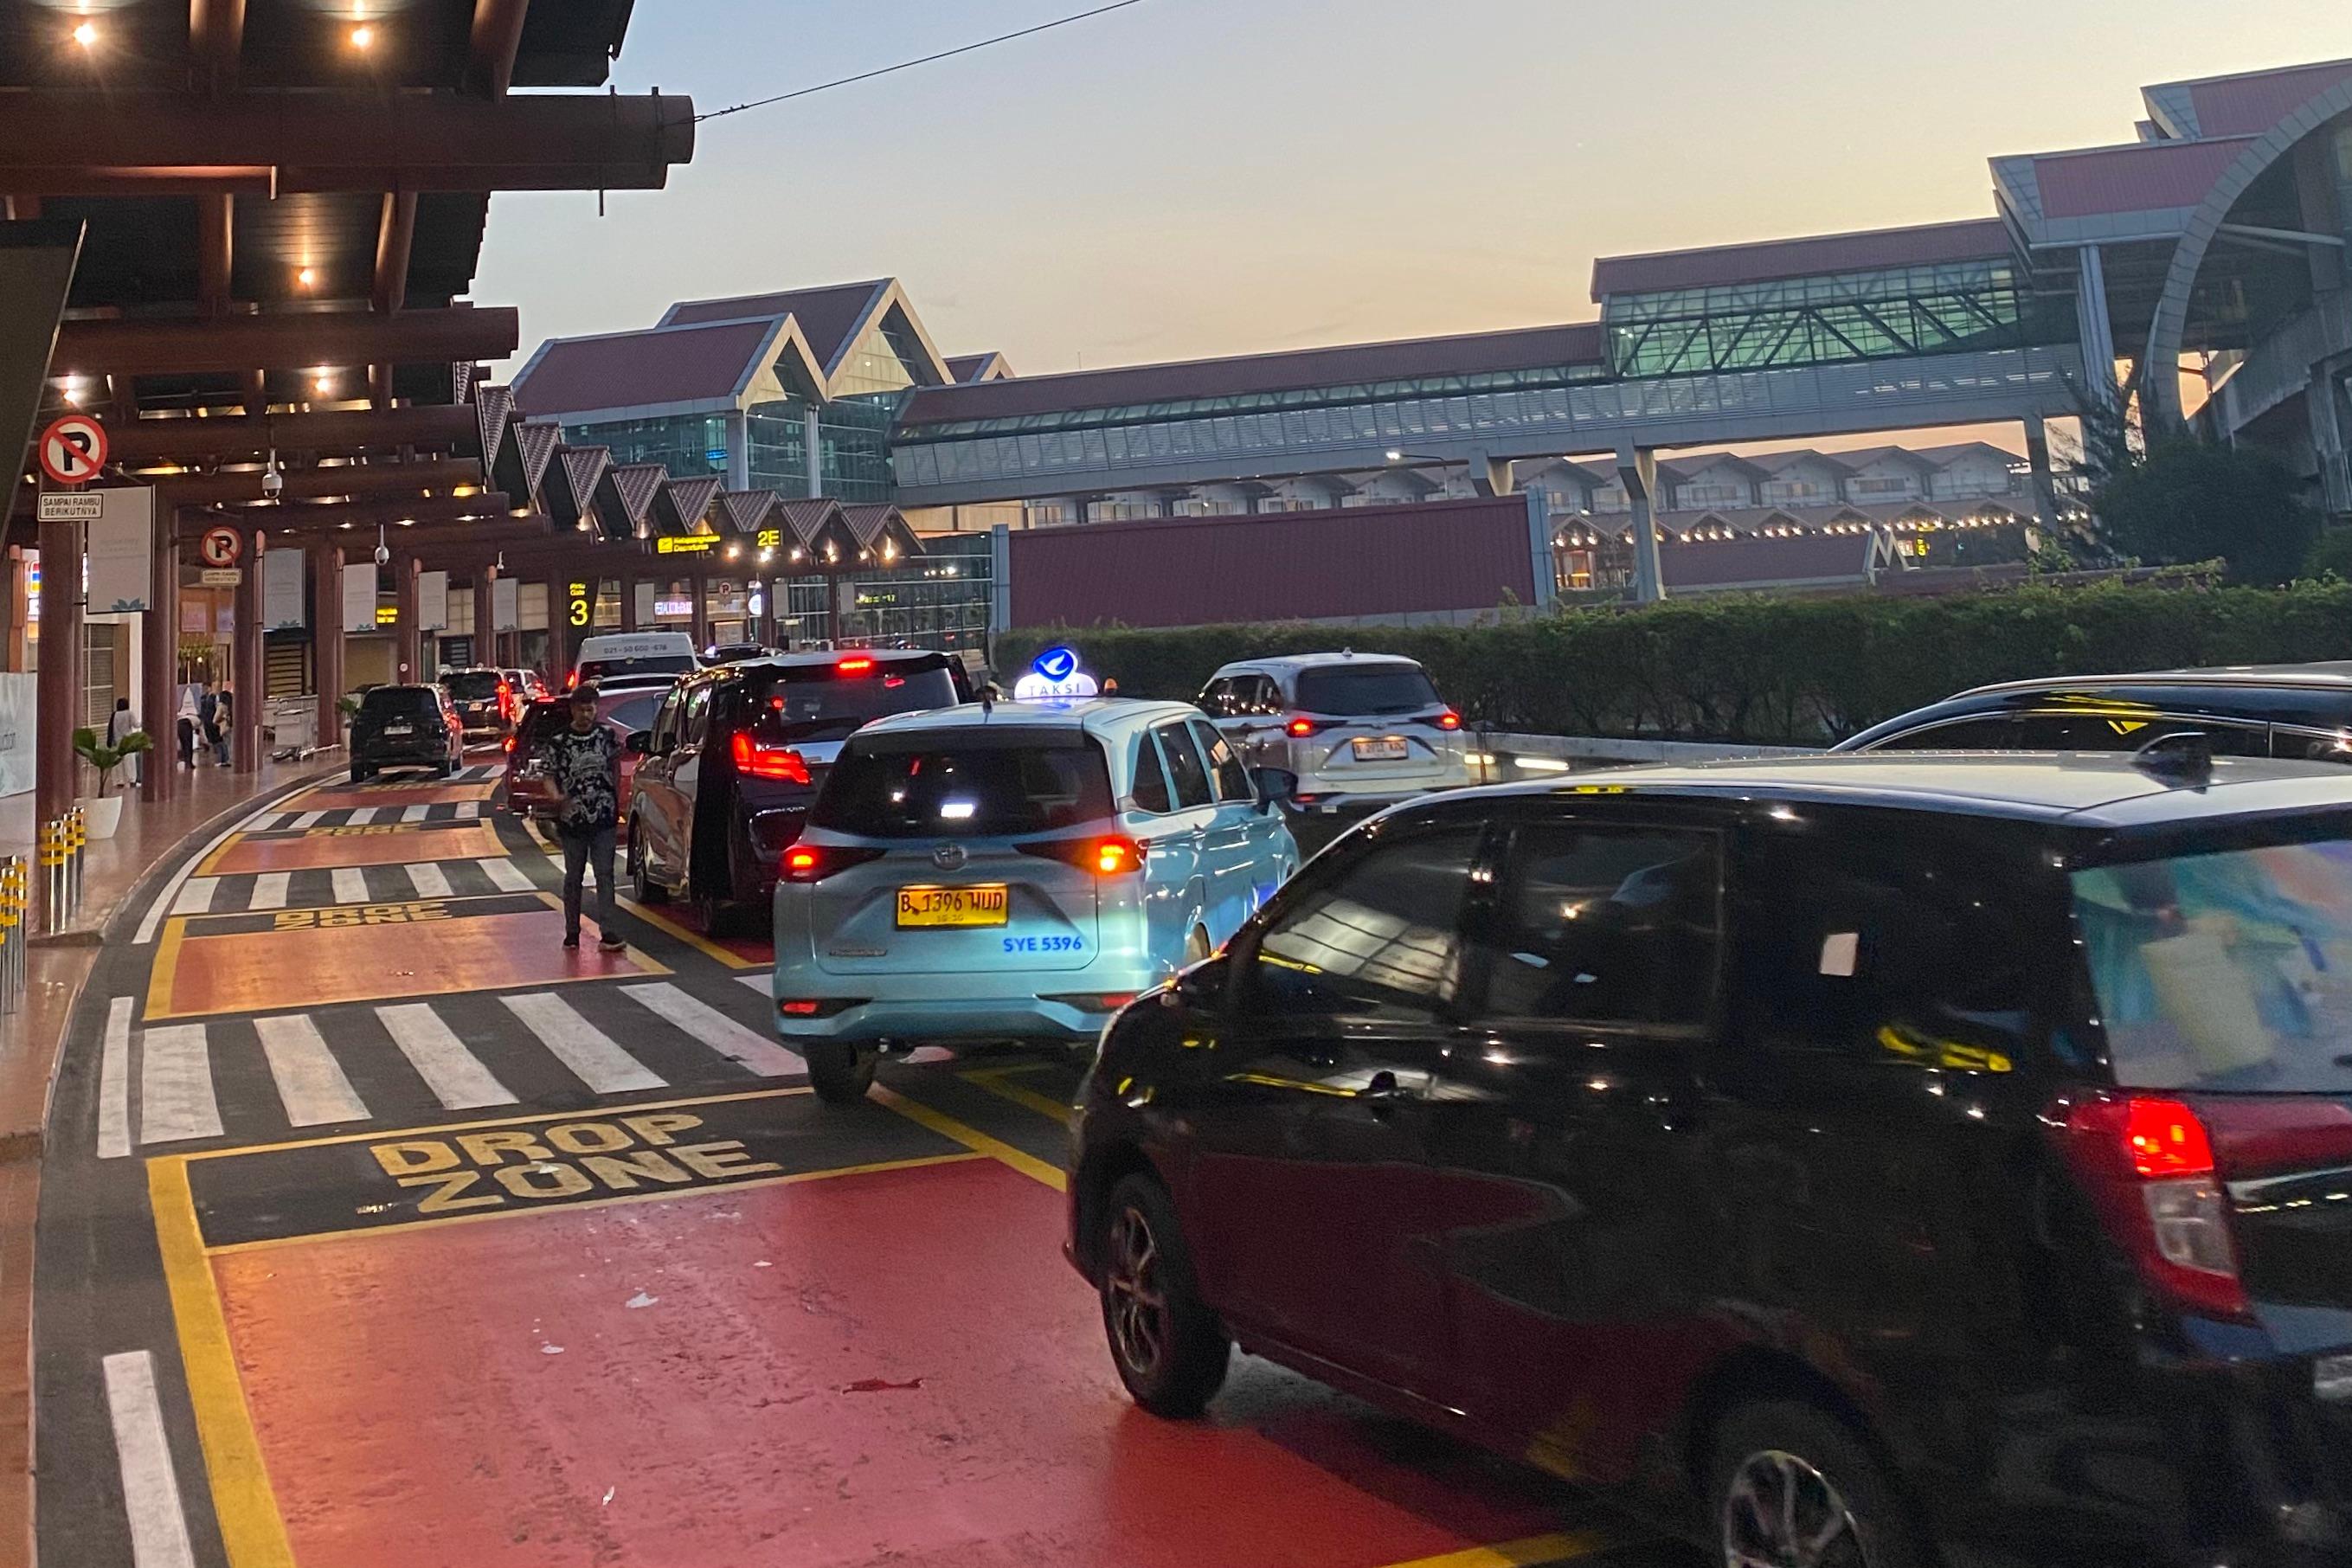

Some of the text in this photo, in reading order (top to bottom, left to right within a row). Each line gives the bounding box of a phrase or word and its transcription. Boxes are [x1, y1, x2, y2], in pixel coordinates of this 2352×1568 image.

[43, 497, 100, 507] SAMPAI RAMBU
[44, 507, 97, 517] BERIKUTNYA
[757, 529, 780, 547] 2E
[570, 599, 588, 626] 3
[1029, 683, 1081, 697] TAKSI
[900, 893, 912, 913] B
[921, 892, 963, 912] 1396
[1003, 935, 1083, 952] SYE 5396
[369, 1113, 704, 1176] DROP
[396, 1140, 783, 1213] ZONE
